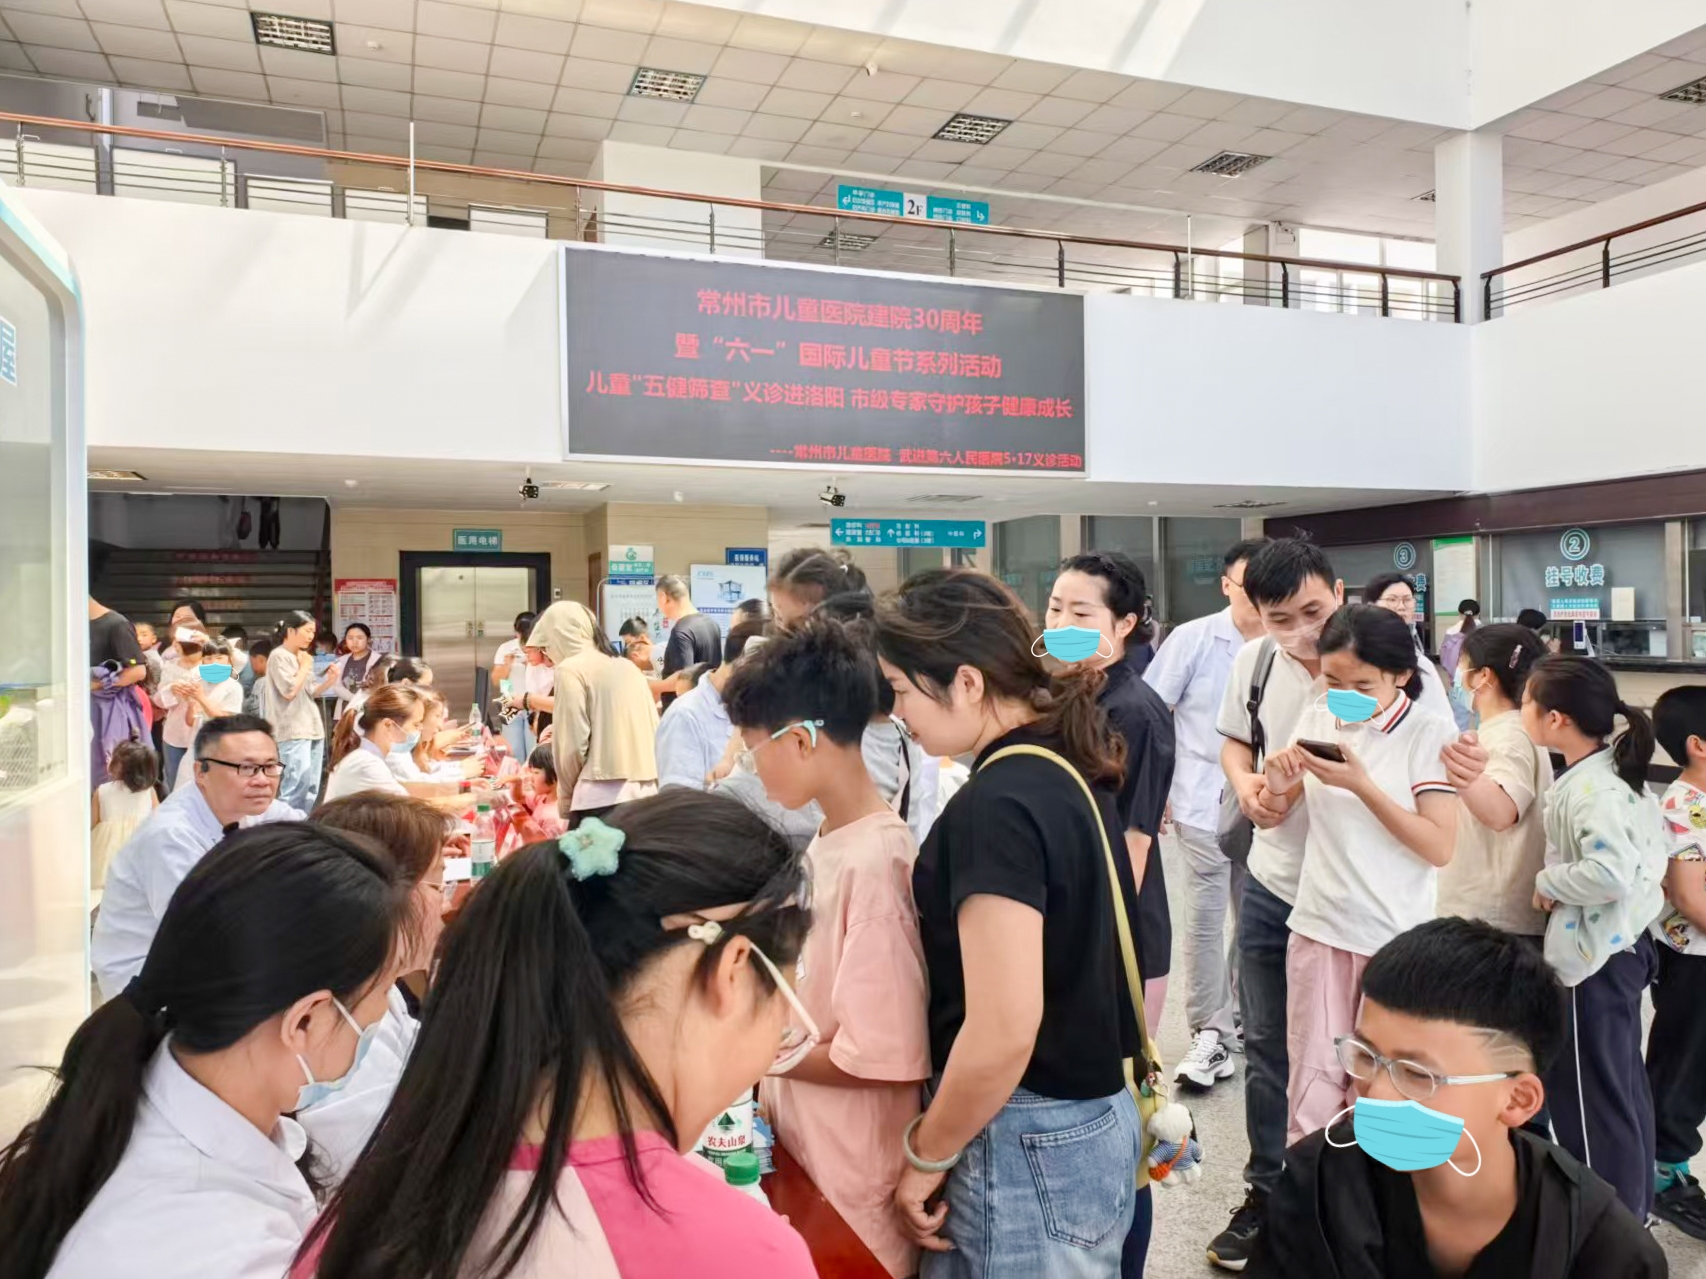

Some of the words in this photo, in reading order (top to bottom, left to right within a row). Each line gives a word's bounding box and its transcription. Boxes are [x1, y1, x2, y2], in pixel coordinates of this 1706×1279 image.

[907, 199, 923, 215] 2F
[697, 288, 983, 335] 常州市儿童医院建院30周年
[851, 388, 1073, 418] 市级专家守护孩子健康成长
[457, 535, 498, 546] 医用电梯
[1544, 563, 1604, 588] 挂号收费
[707, 1135, 746, 1148] 农夫山泉
